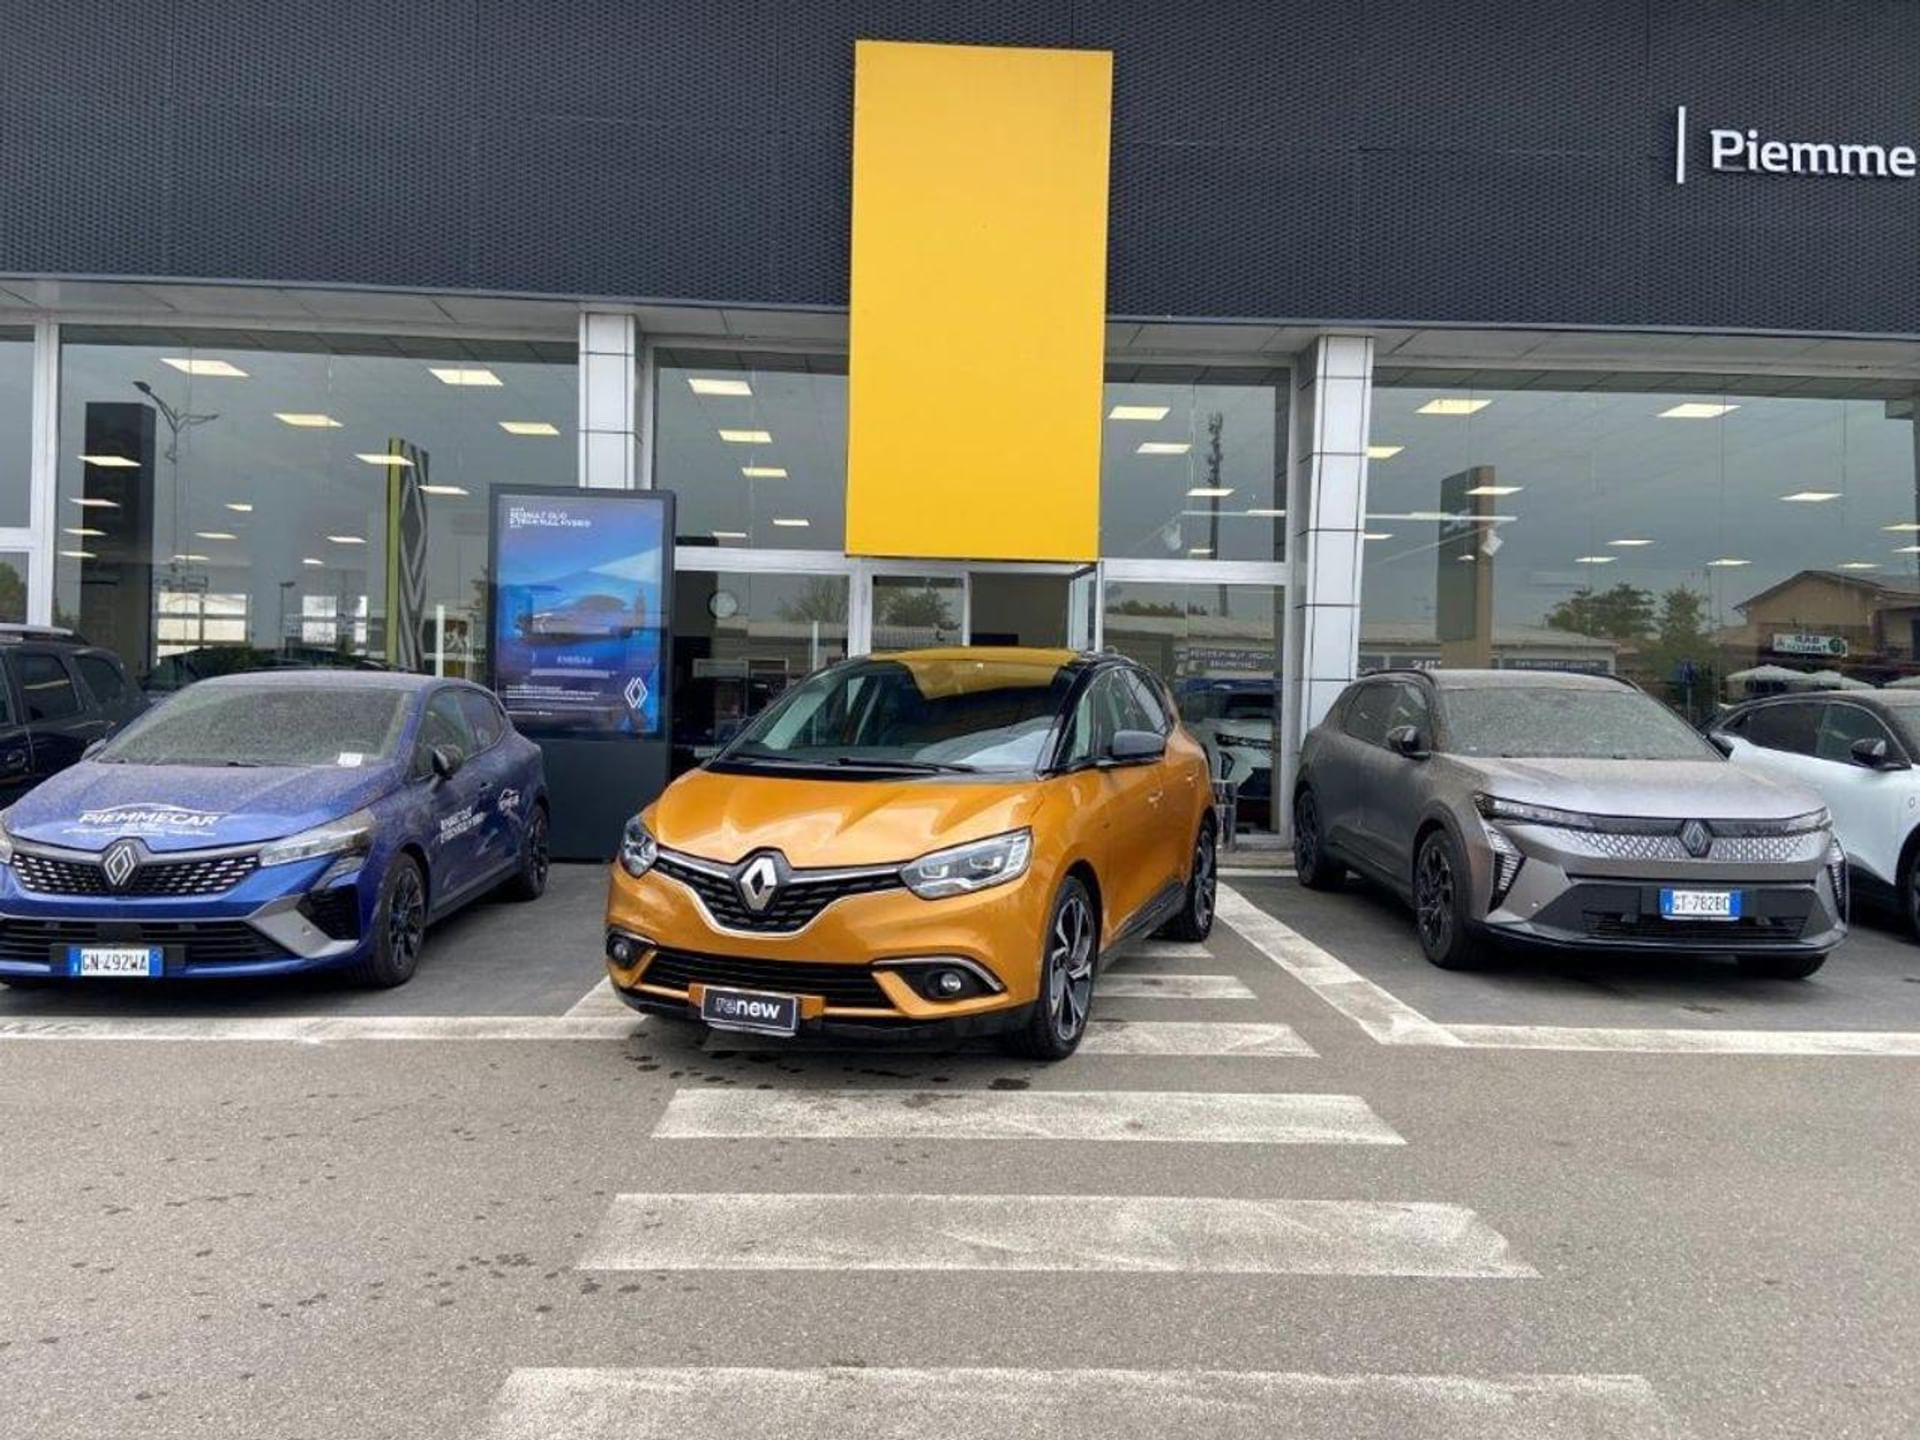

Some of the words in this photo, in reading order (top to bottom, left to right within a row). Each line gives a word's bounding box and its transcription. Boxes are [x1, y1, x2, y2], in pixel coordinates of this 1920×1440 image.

[1710, 130, 1917, 176] Piemme
[80, 810, 220, 827] PIEMMECAR
[716, 997, 781, 1019] renew
